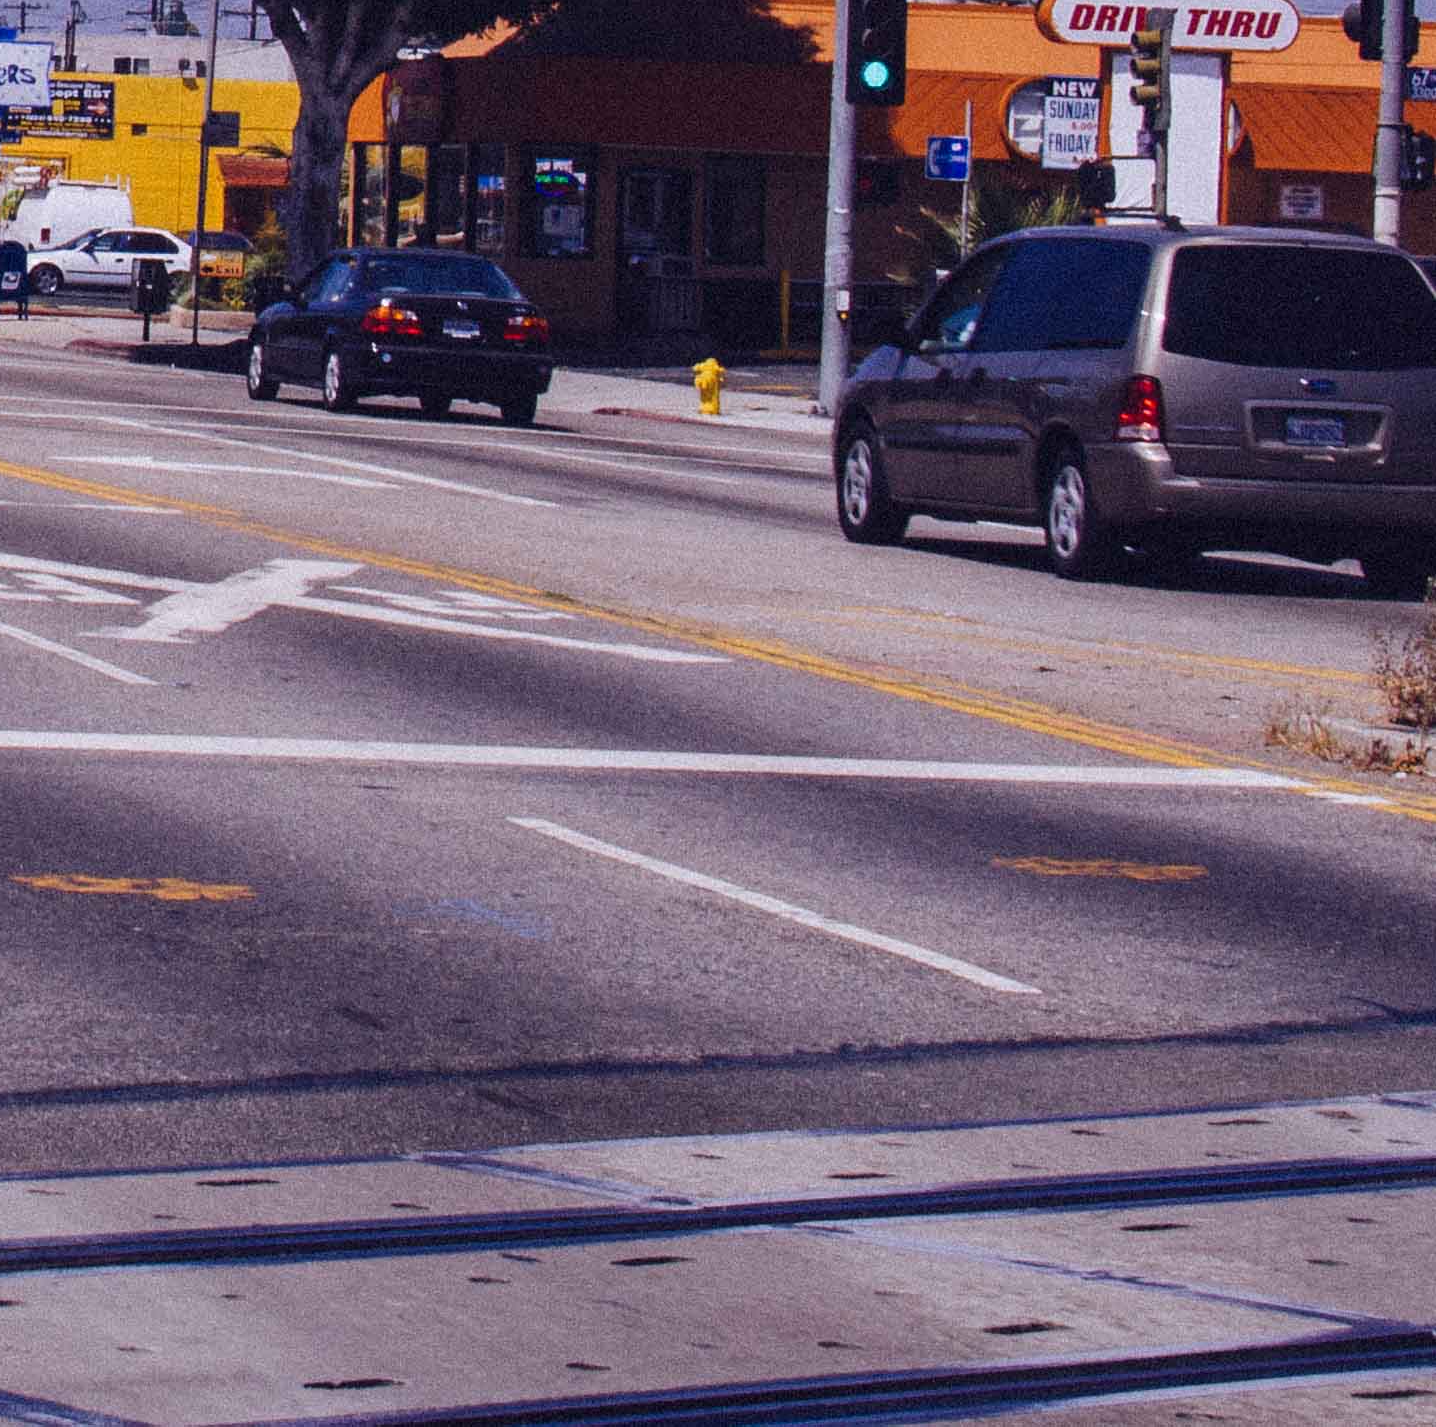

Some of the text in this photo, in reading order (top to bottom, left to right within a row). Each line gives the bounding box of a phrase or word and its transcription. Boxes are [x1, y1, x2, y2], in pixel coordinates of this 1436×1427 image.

[1186, 8, 1282, 39] THRU
[1053, 81, 1096, 97] NEW
[1049, 100, 1096, 119] SUNDAY
[1048, 133, 1089, 153] FRIDAY
